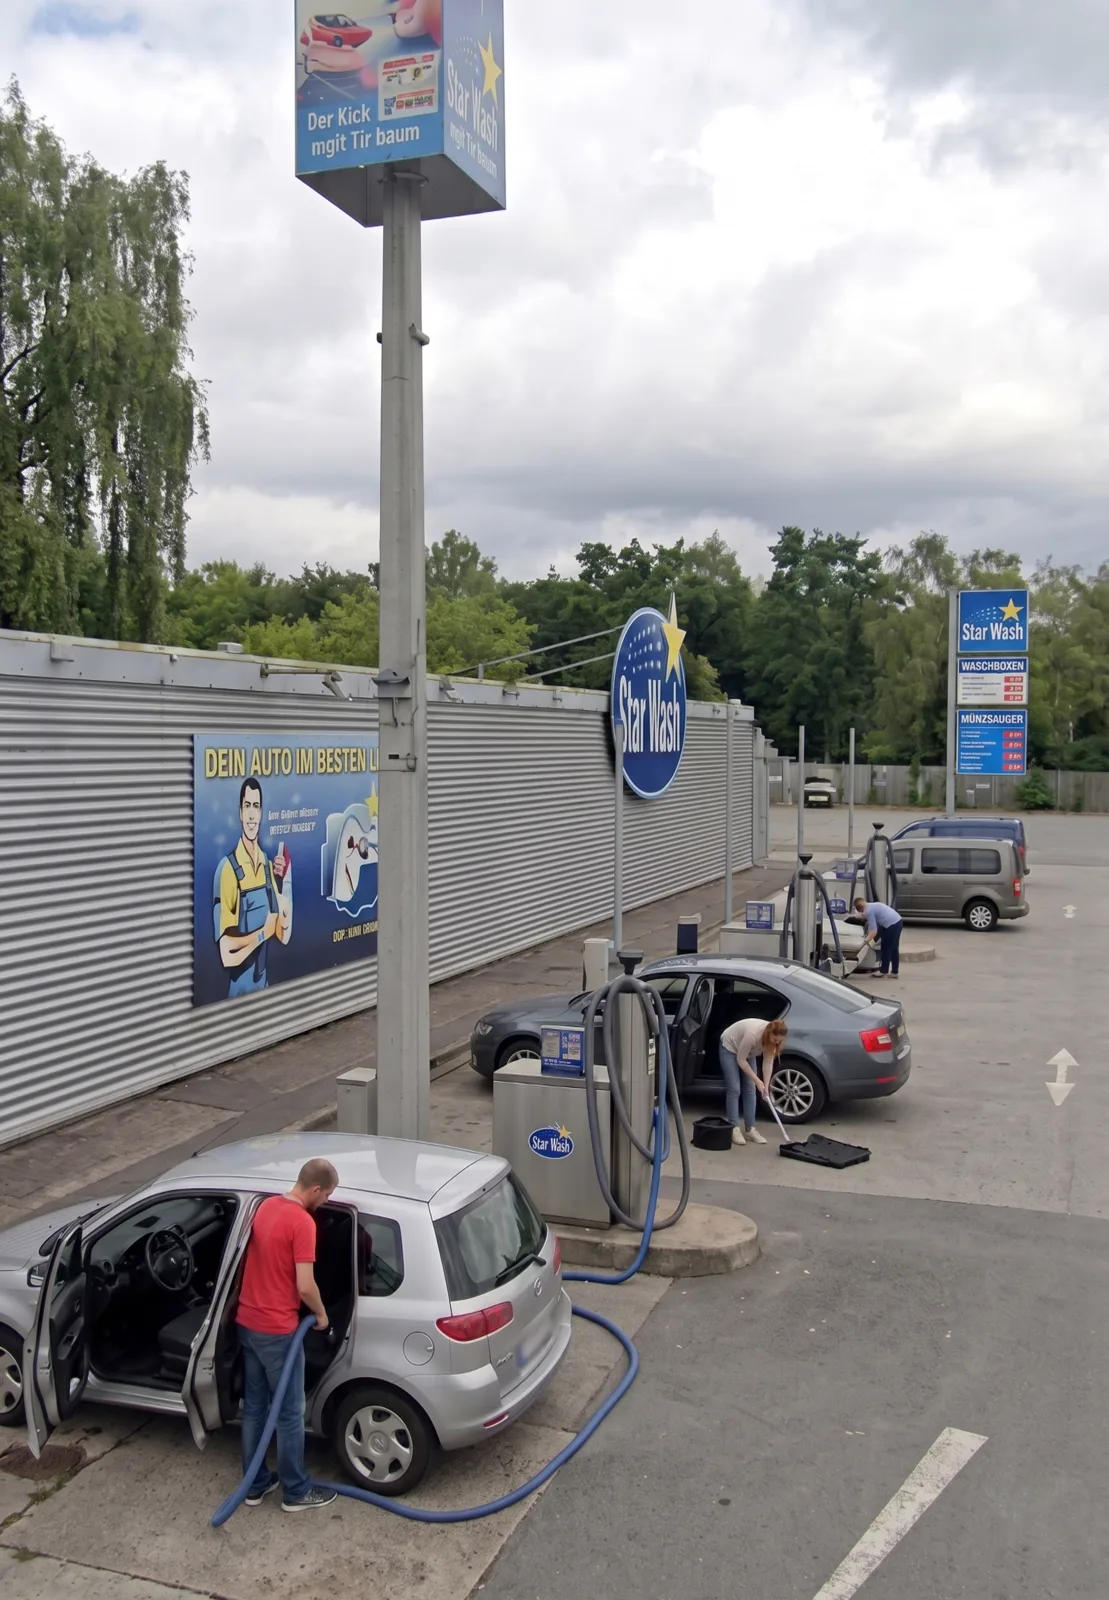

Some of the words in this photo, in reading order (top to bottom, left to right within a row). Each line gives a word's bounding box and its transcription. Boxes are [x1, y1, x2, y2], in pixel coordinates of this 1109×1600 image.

[308, 112, 334, 131] Der
[338, 103, 371, 127] Kick
[447, 58, 469, 122] Star
[471, 78, 498, 153] Wash
[312, 133, 347, 158] mgit
[351, 130, 371, 149] Tir
[376, 125, 420, 146] baum
[962, 623, 989, 641] Star
[990, 622, 1024, 640] Wash
[961, 661, 1025, 671] WASCHBOXEN
[619, 674, 646, 753] Star
[648, 678, 680, 753] Wash
[961, 712, 1024, 724] MÜNZSAUGER
[205, 748, 246, 778] DEIN
[250, 747, 292, 776] AUTO
[296, 747, 313, 774] IM
[317, 747, 366, 773] BESTEN
[532, 1135, 549, 1150] Star
[550, 1137, 570, 1153] Wash
